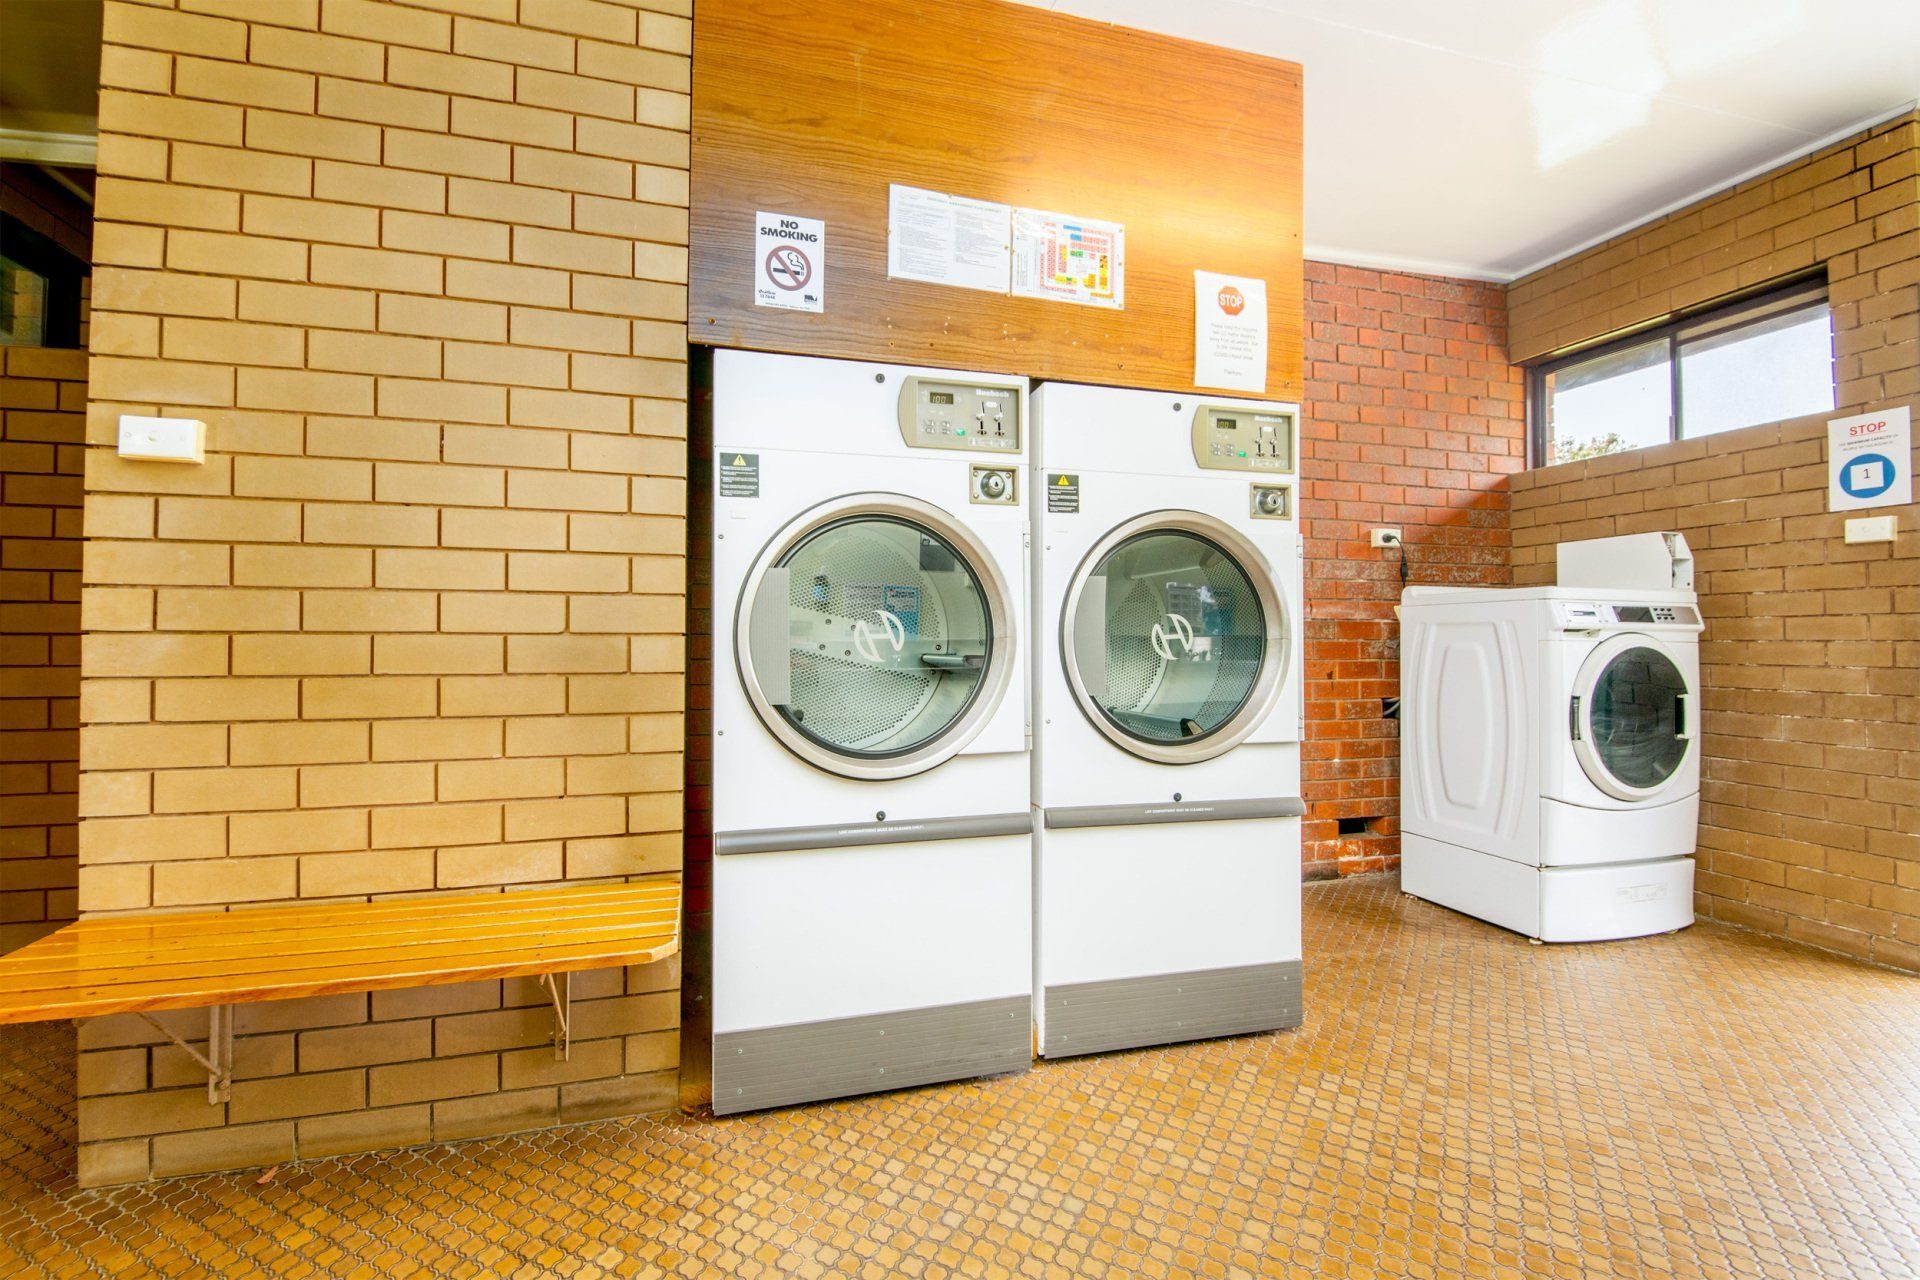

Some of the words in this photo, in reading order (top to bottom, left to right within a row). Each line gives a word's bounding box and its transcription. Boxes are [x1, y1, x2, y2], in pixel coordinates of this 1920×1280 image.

[780, 219, 799, 229] NO
[760, 226, 818, 243] SMOKING
[1219, 294, 1243, 308] STOP
[1849, 421, 1887, 436] STOP
[1863, 468, 1871, 479] 1
